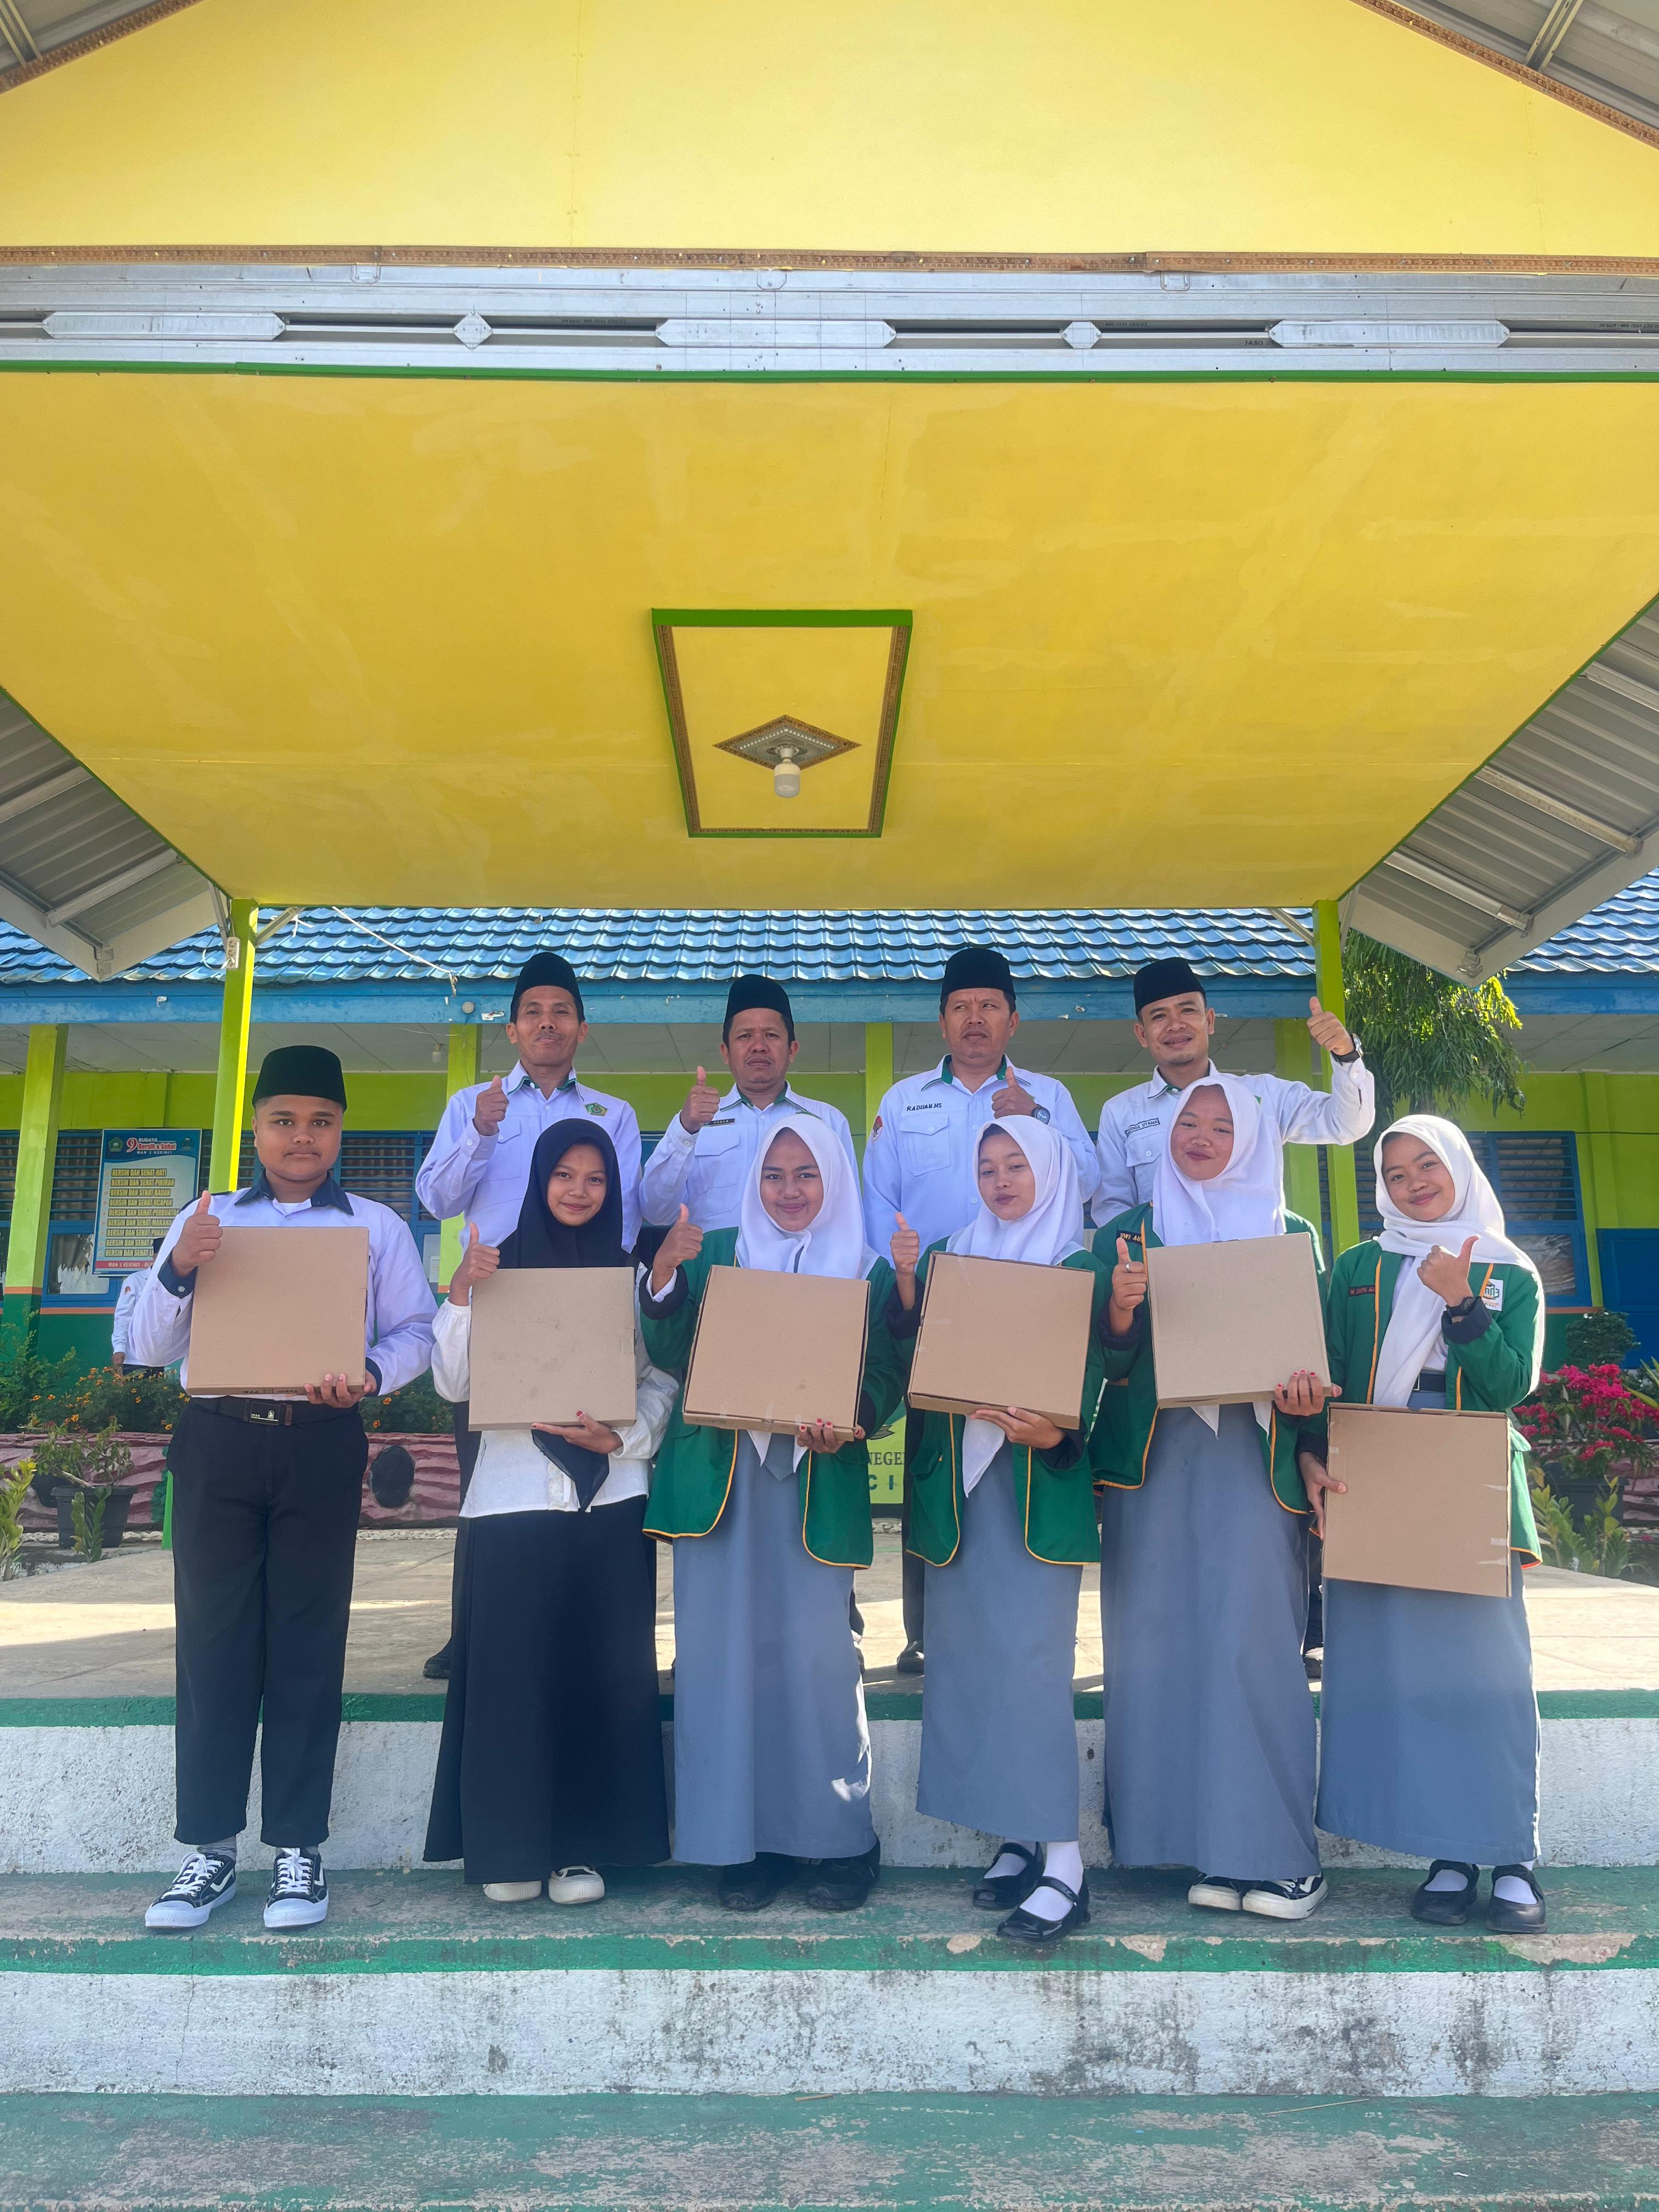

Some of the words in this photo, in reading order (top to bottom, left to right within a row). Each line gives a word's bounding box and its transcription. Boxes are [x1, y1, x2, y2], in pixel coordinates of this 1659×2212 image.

[127, 1137, 138, 1153] 9
[112, 1169, 129, 1177] BERSIH
[130, 1169, 140, 1177] DAN
[140, 1169, 155, 1177] SEHAT
[156, 1169, 167, 1177] HATI
[111, 1178, 128, 1187] BERSIH
[129, 1178, 139, 1187] DAN
[140, 1178, 155, 1187] SEHAT
[155, 1178, 175, 1187] PIKIRAN
[108, 1218, 125, 1227] BERSIH
[126, 1218, 137, 1227] DAN
[137, 1218, 151, 1227] SEHAT
[106, 1228, 125, 1237] BERSIH
[125, 1228, 136, 1237] DAN
[136, 1228, 151, 1237] SEHAT
[106, 1239, 124, 1247] BERSIH
[125, 1239, 135, 1247] DAN
[135, 1239, 150, 1247] SEHAT
[105, 1249, 123, 1257] BERSIH
[123, 1249, 134, 1257] DAN
[134, 1249, 149, 1257] SEHAT
